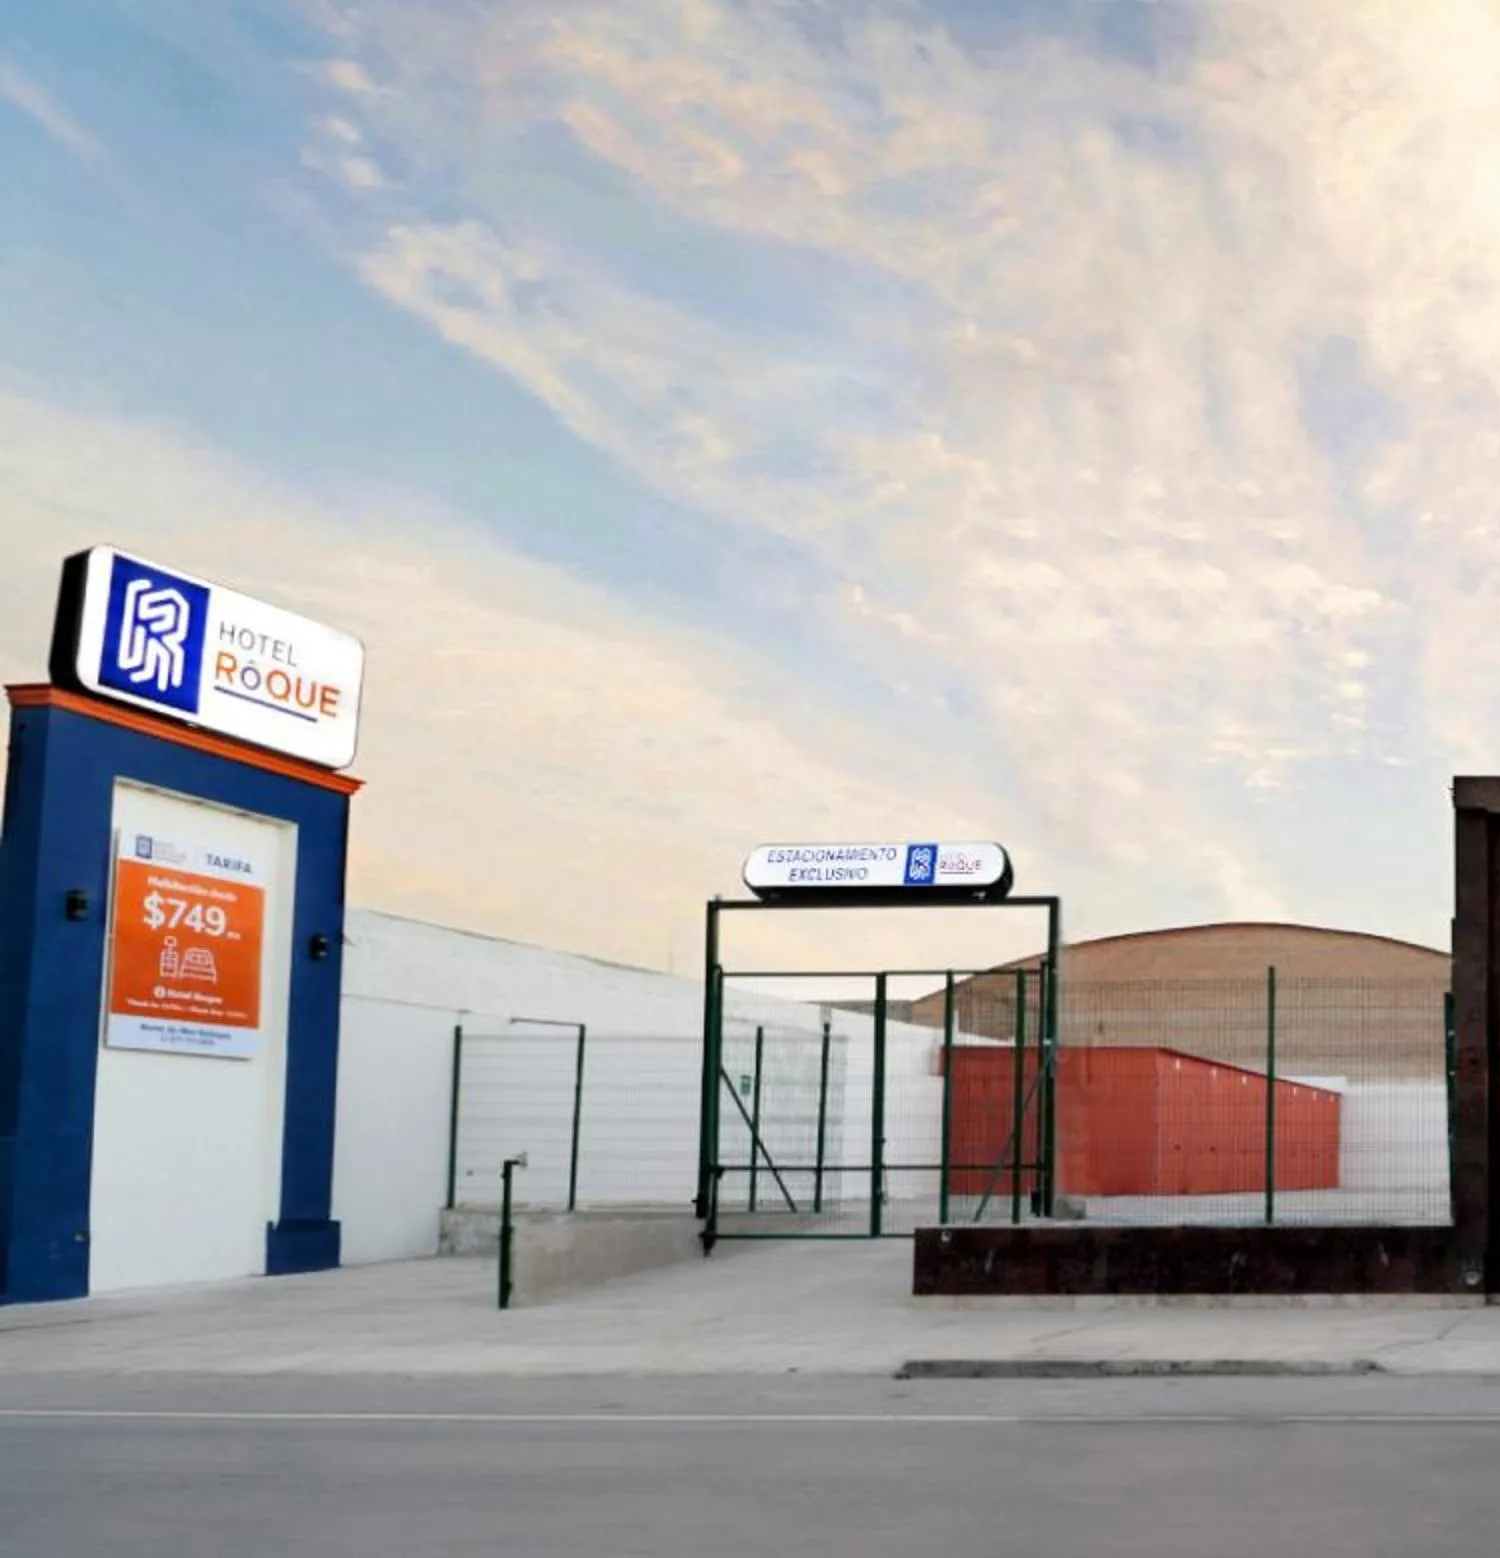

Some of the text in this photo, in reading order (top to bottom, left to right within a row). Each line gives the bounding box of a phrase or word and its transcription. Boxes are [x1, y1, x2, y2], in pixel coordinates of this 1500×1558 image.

[219, 619, 298, 668] HOTEL
[206, 853, 252, 873] TARIFA
[767, 847, 897, 863] ESTACIONAMIENTO
[788, 867, 868, 882] EXCLUSIVO
[143, 890, 227, 937] $749
